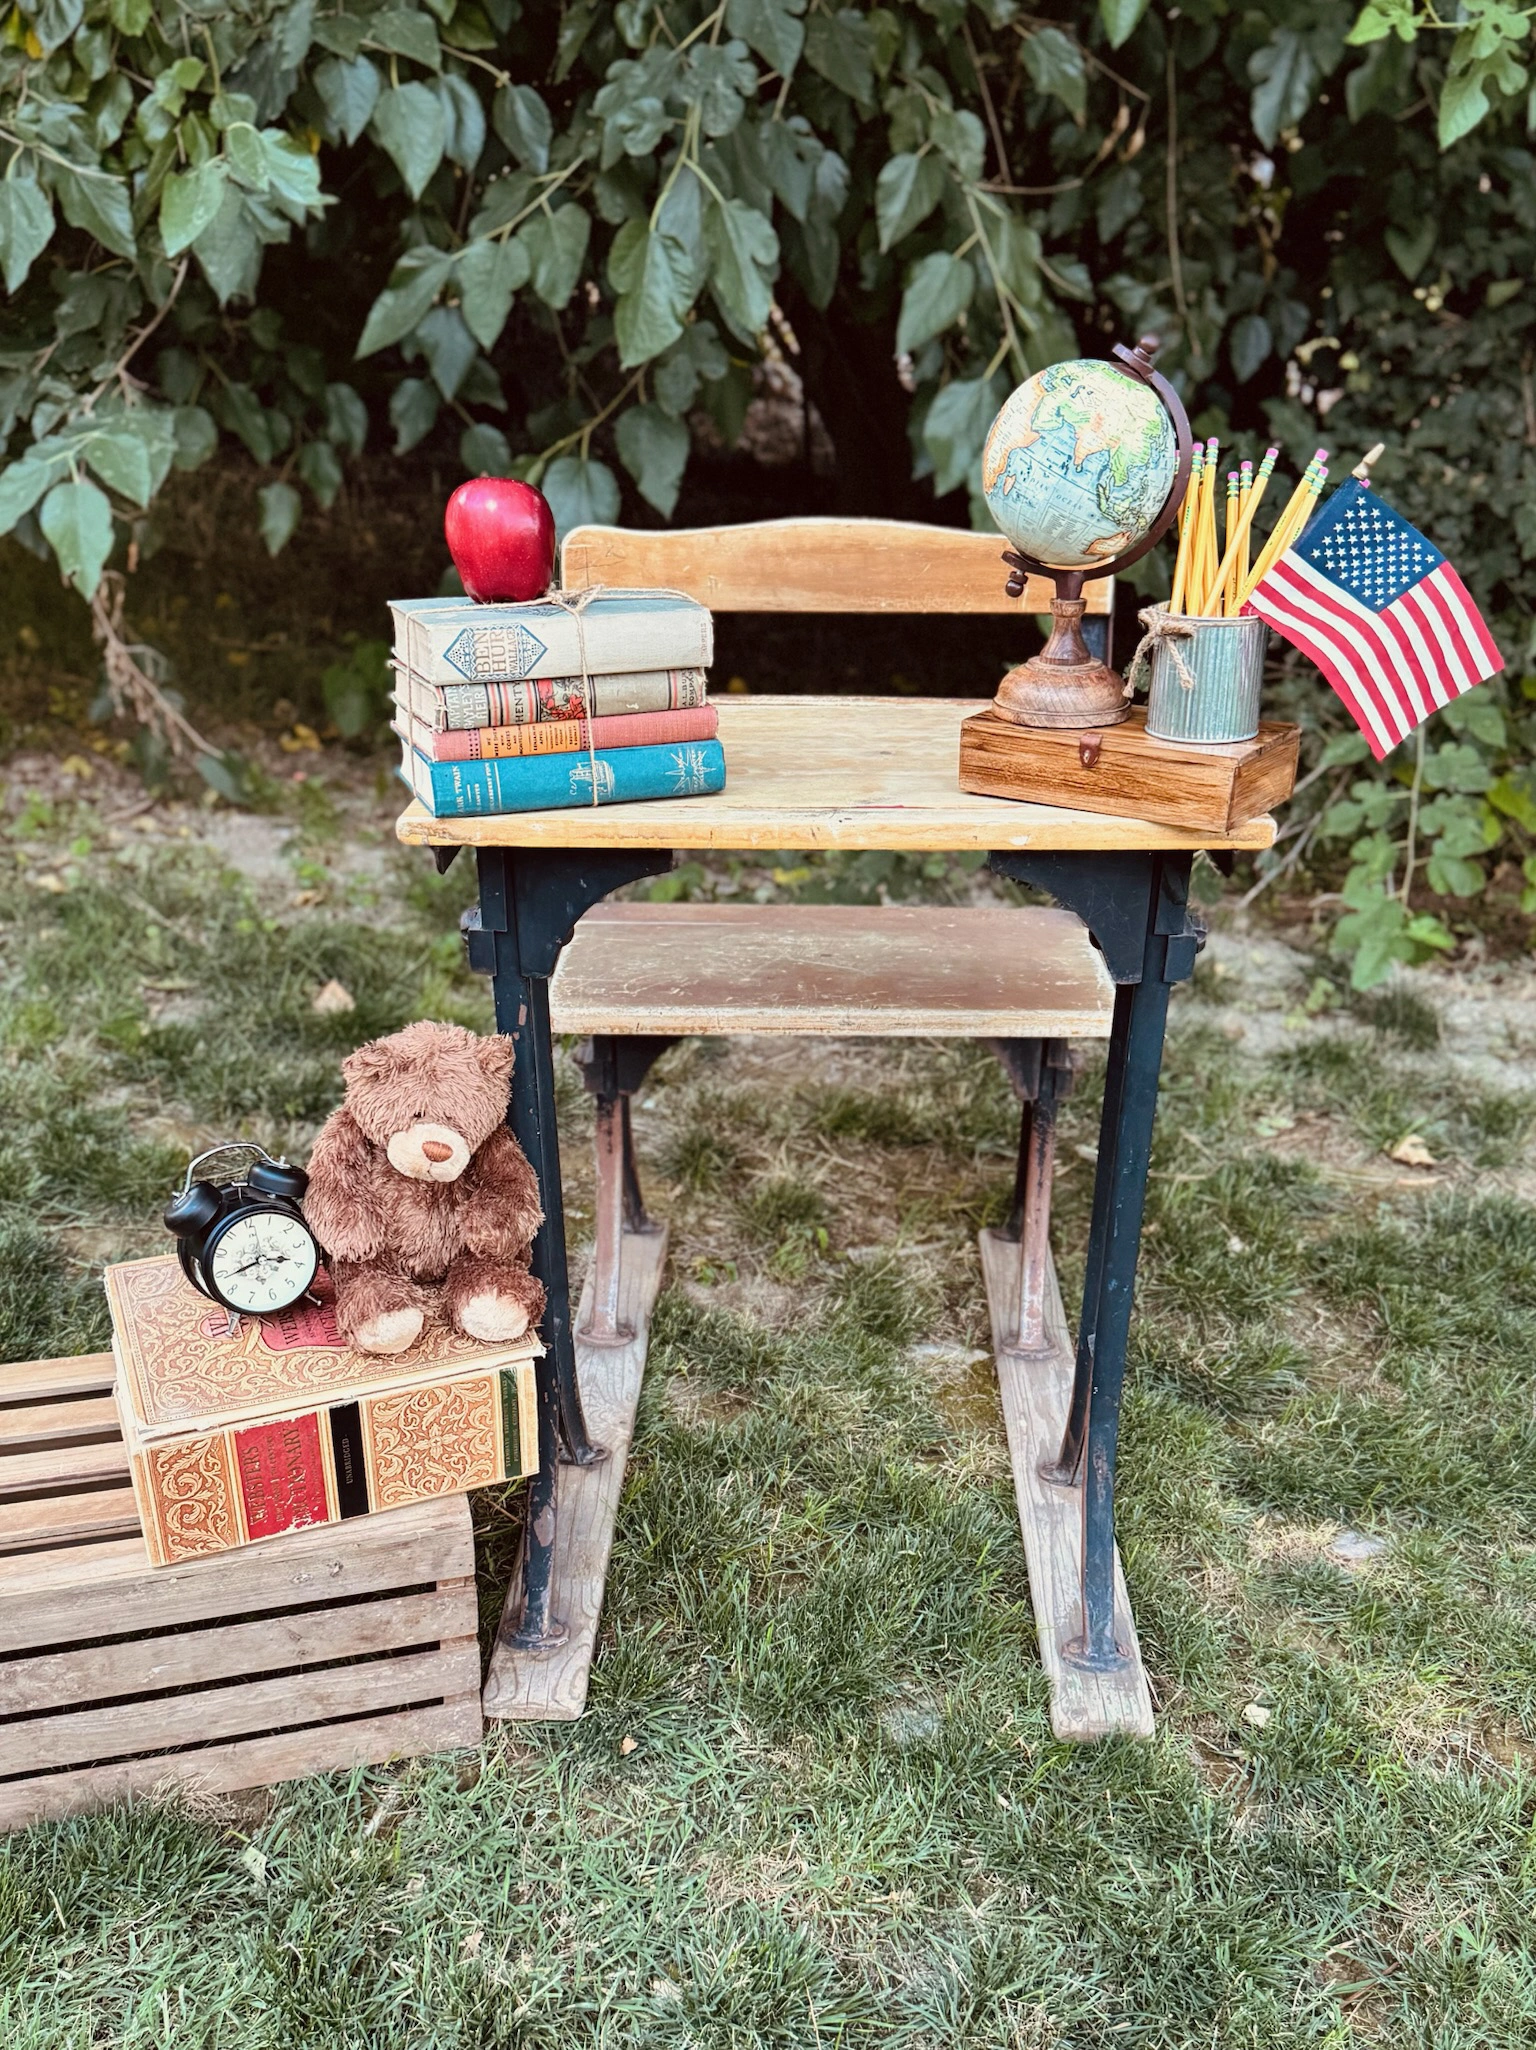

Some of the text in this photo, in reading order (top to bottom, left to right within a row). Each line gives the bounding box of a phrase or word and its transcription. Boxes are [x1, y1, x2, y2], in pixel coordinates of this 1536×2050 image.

[475, 632, 491, 673] BEN
[490, 630, 507, 673] HUR
[507, 629, 518, 674] WALLACE
[687, 670, 695, 707] COMPAN
[446, 684, 461, 729] CAPTAIN
[475, 692, 488, 720] HEIR
[513, 681, 524, 724] HENTY
[452, 765, 464, 814] ARK TWAIN
[244, 1216, 255, 1228] 12
[267, 1216, 272, 1226] 1
[283, 1222, 295, 1234] 2
[226, 1231, 237, 1240] 11
[293, 1240, 305, 1249] 3
[215, 1247, 228, 1259] 10
[294, 1261, 306, 1269] 4
[215, 1269, 229, 1279] 9
[226, 1284, 238, 1295] 8
[284, 1278, 296, 1288] 5
[248, 1291, 256, 1304] 7
[268, 1288, 277, 1301] 6
[283, 1427, 311, 1522] DICTIONARY
[241, 1446, 268, 1525] WEBSTER'S
